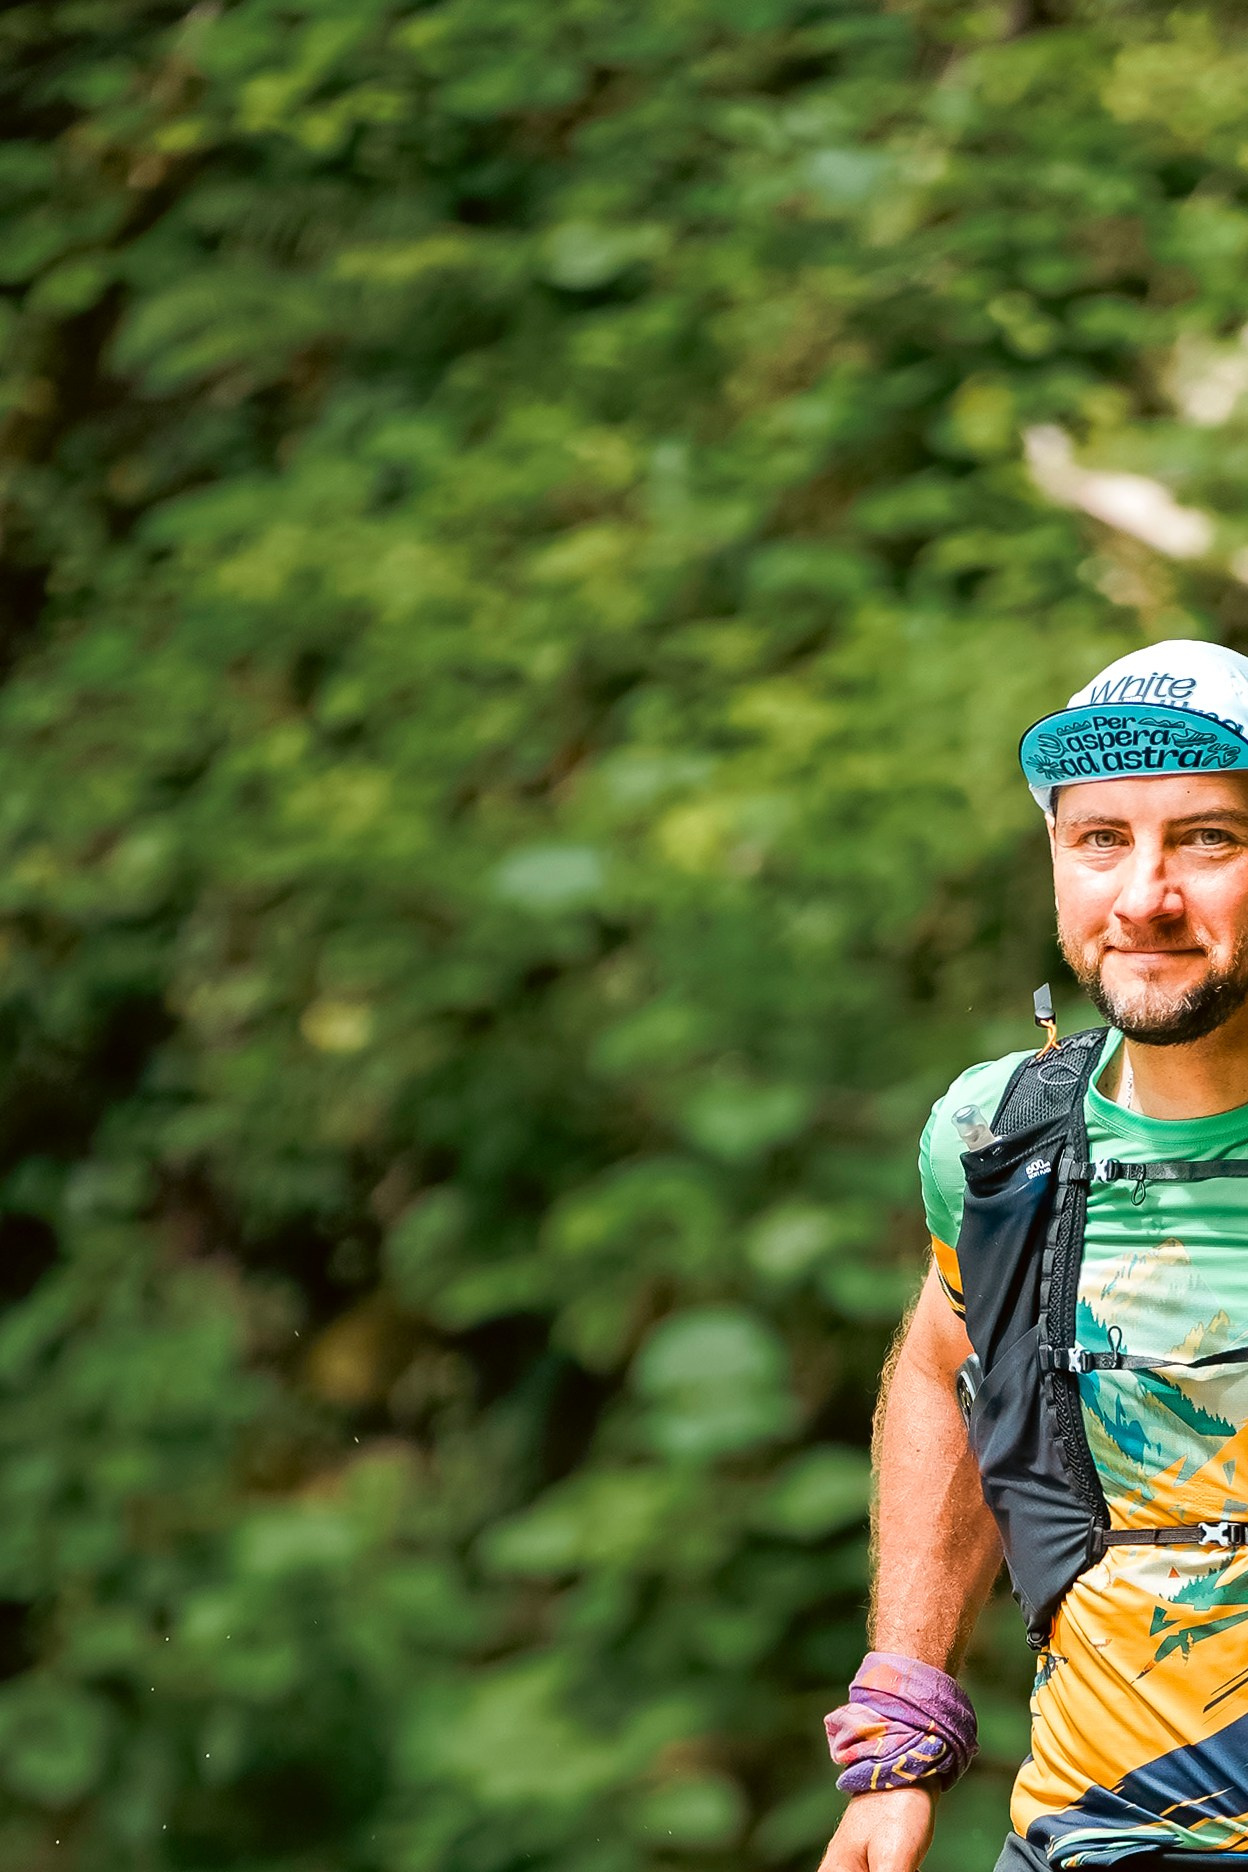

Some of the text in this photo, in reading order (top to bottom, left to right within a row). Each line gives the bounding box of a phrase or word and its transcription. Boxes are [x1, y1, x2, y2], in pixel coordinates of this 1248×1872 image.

[1093, 716, 1137, 731] Per
[1066, 728, 1171, 752] aspera
[1060, 745, 1204, 777] ad astra
